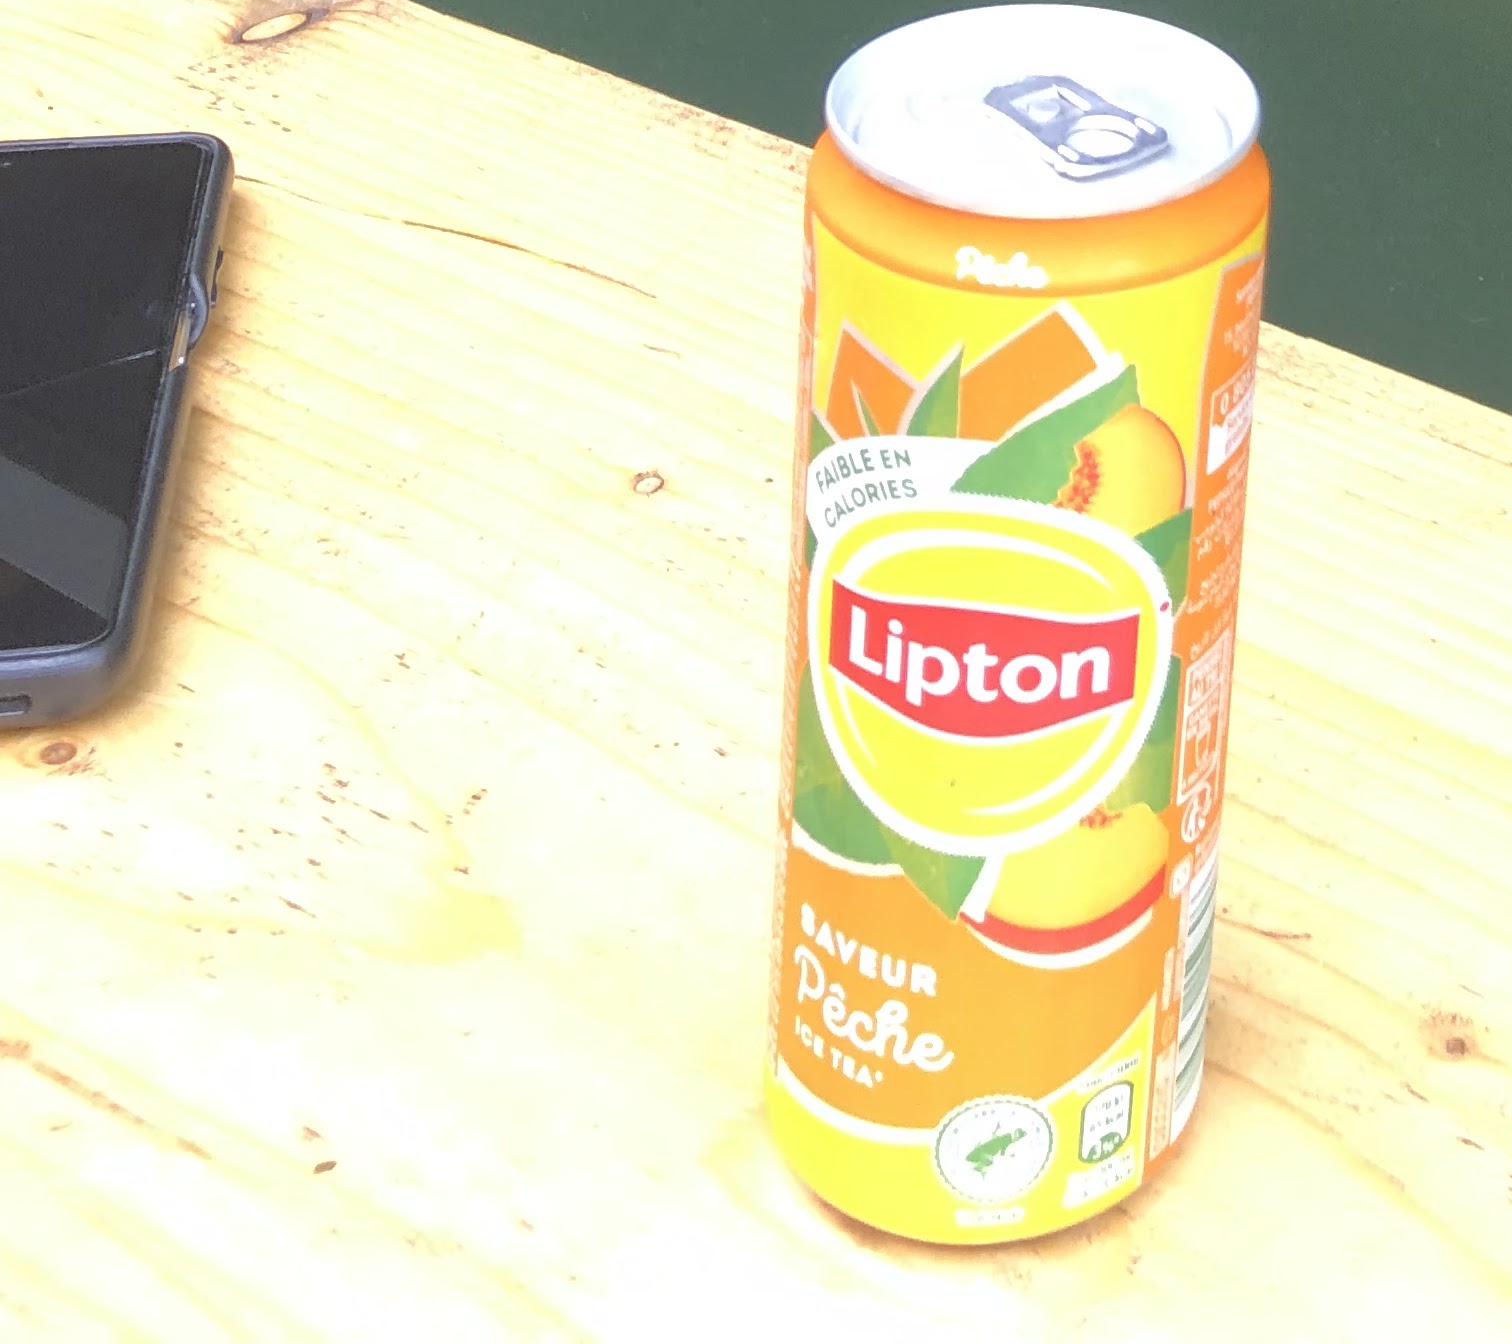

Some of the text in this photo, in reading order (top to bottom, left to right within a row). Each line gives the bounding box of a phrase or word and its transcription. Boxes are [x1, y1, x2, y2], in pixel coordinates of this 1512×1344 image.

[816, 448, 911, 494] FAIBLE EN
[824, 478, 917, 528] CALORIES
[849, 604, 1110, 706] Lipton
[801, 902, 937, 997] SAVEUR
[794, 944, 954, 1072] Pêche
[795, 1015, 825, 1059] ICE
